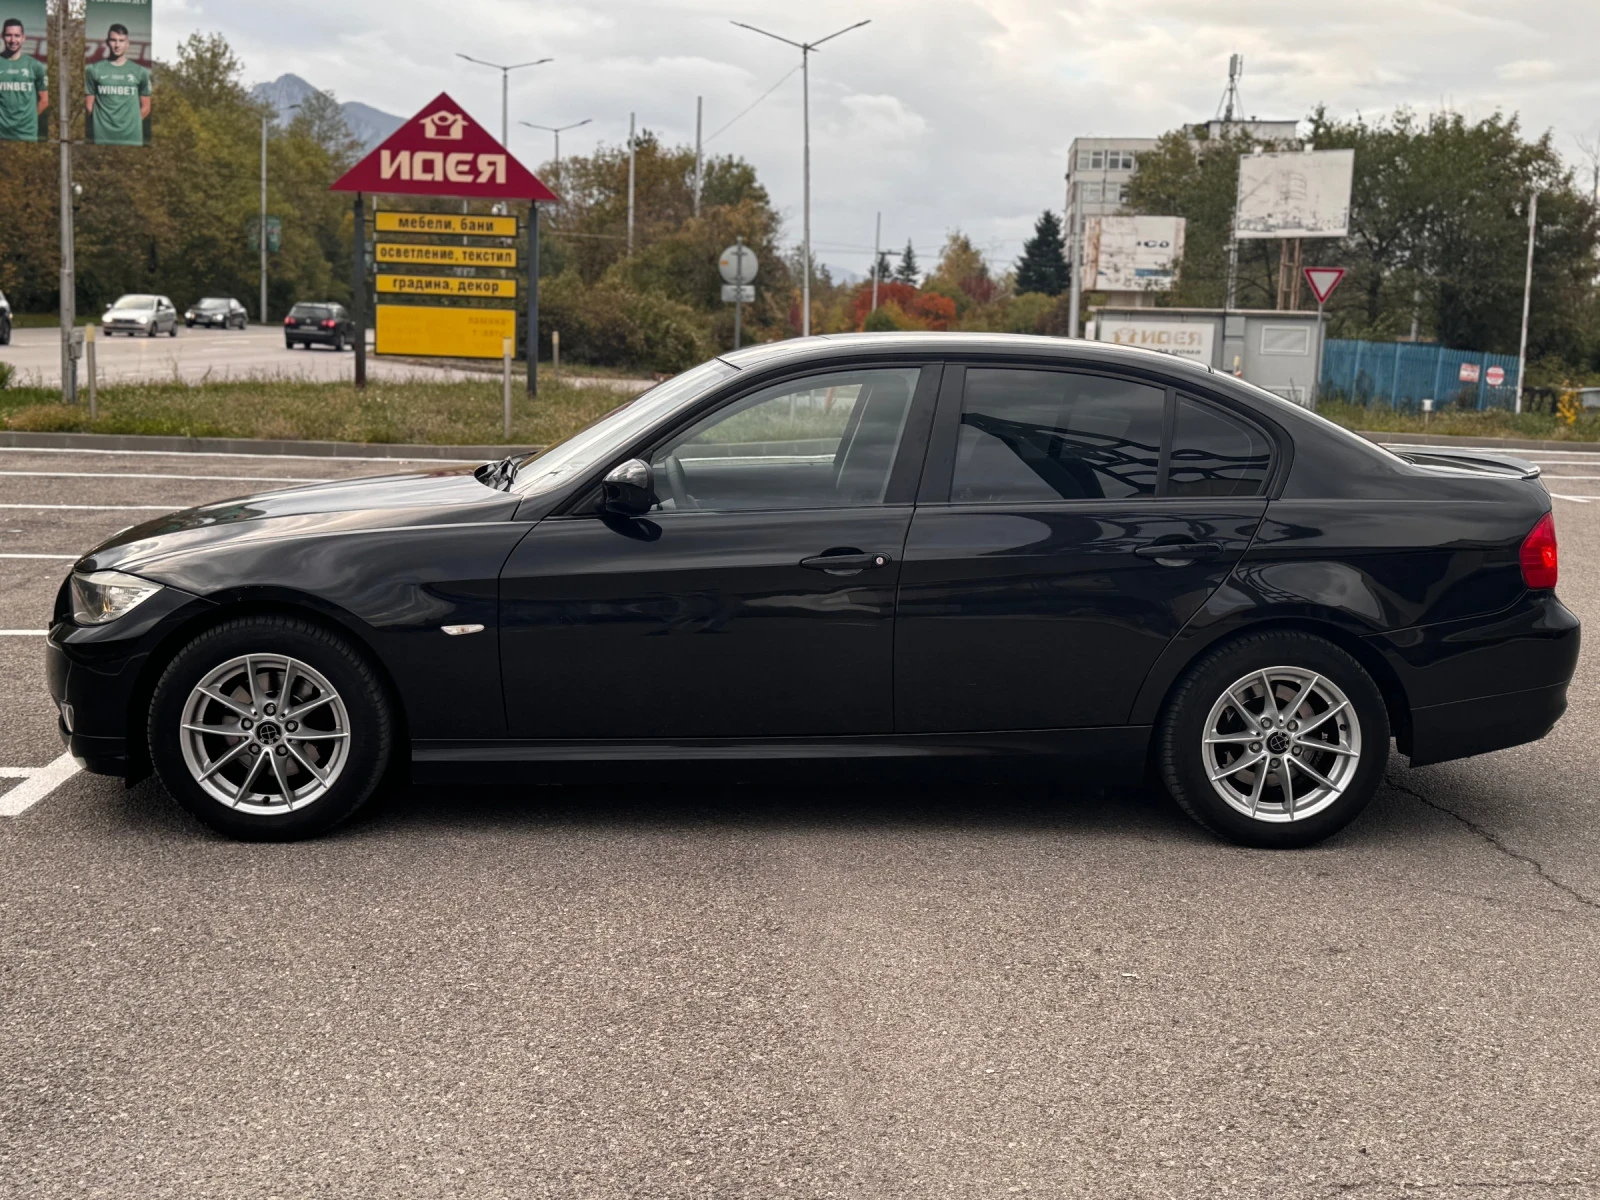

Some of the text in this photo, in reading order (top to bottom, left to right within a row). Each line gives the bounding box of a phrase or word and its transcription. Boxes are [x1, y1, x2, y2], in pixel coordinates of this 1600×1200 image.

[97, 85, 137, 95] WINBET
[380, 149, 506, 184] ИДЕЯ
[398, 217, 494, 231] мебели, бани
[380, 247, 512, 262] осветление, текстил
[393, 278, 499, 294] градина, декор
[1140, 329, 1203, 346] ИДЕЯ
